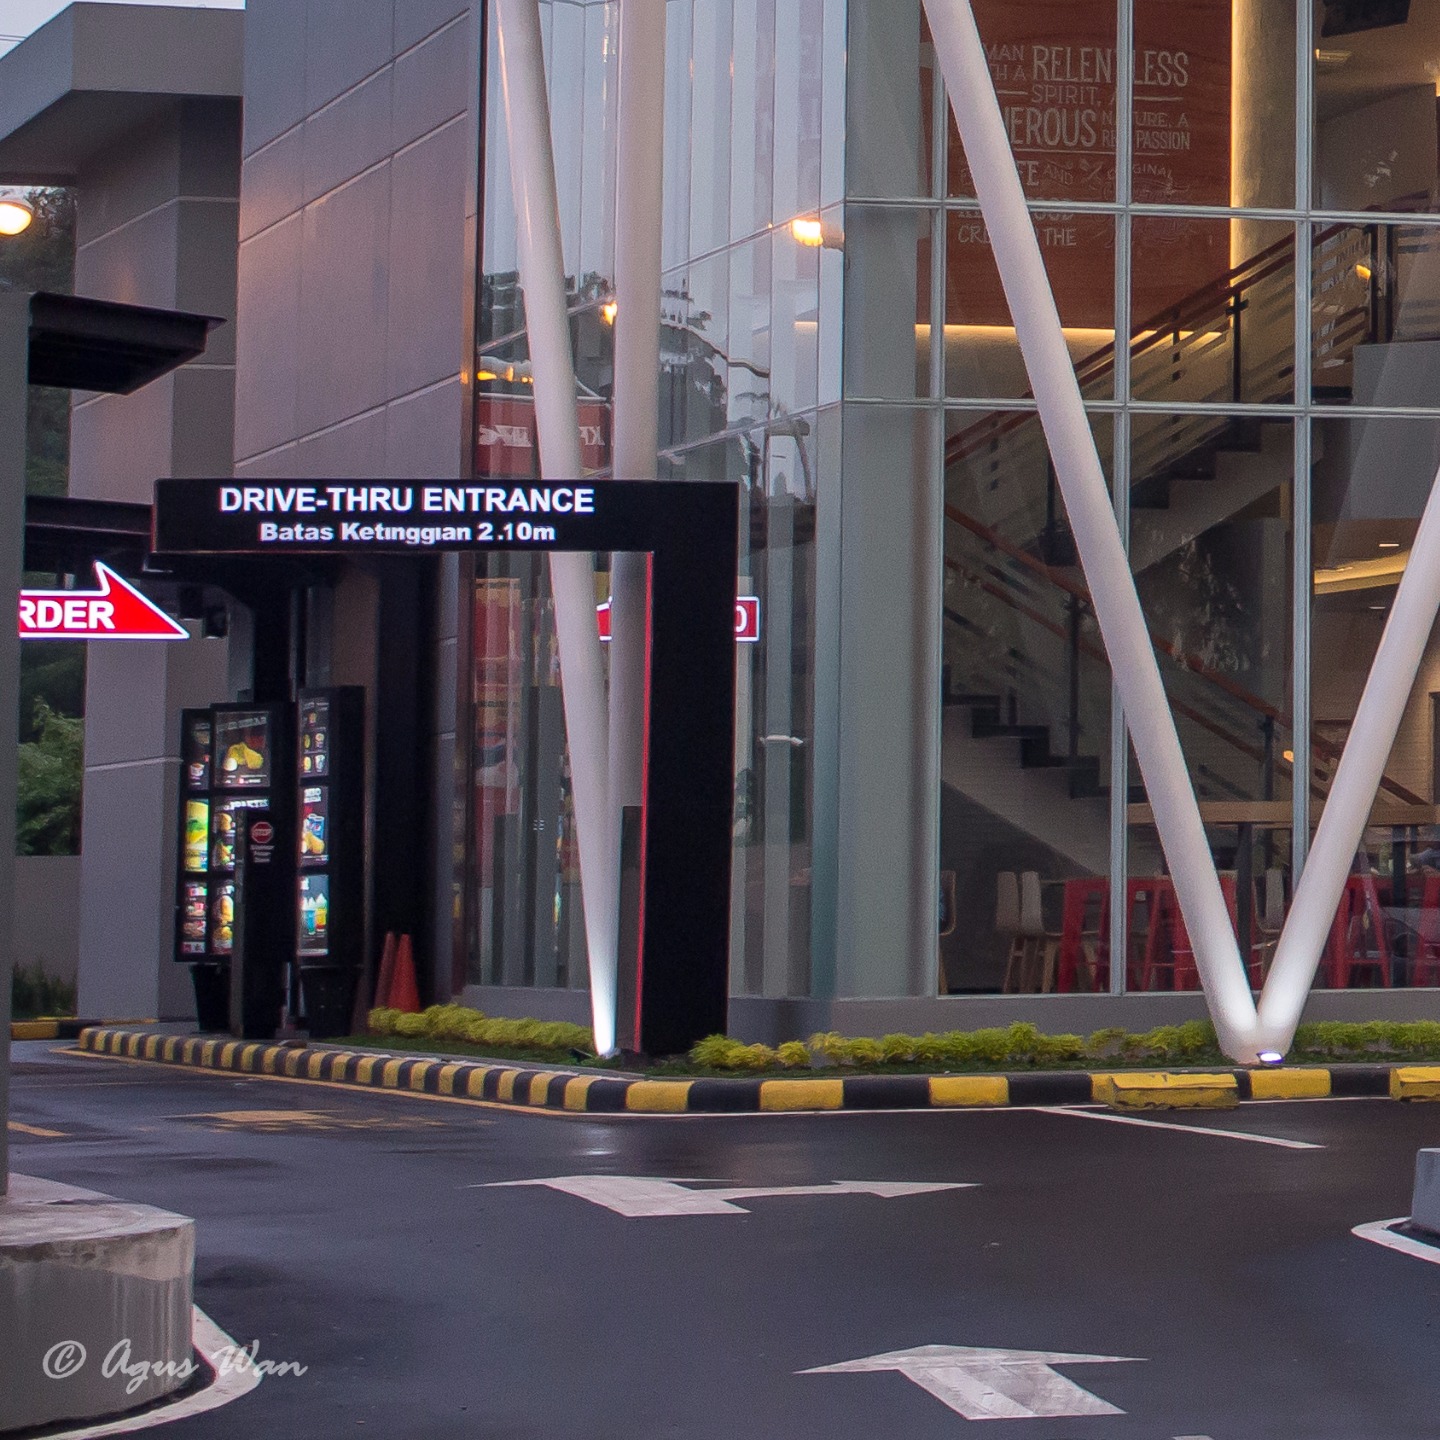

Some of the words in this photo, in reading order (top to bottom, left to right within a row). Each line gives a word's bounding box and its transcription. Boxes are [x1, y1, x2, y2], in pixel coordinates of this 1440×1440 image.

[1032, 45, 1189, 87] RELENLESS
[1004, 106, 1098, 148] EROUS
[1102, 111, 1175, 128] NURE,
[1135, 130, 1191, 150] PASSION
[1042, 226, 1078, 247] THE
[219, 487, 413, 513] DRIVE-THRU
[423, 487, 595, 513] ENTRANCE
[260, 521, 334, 542] Batas
[341, 521, 472, 546] Ketinggian
[478, 521, 556, 542] 2.10m
[20, 600, 116, 629] RDER
